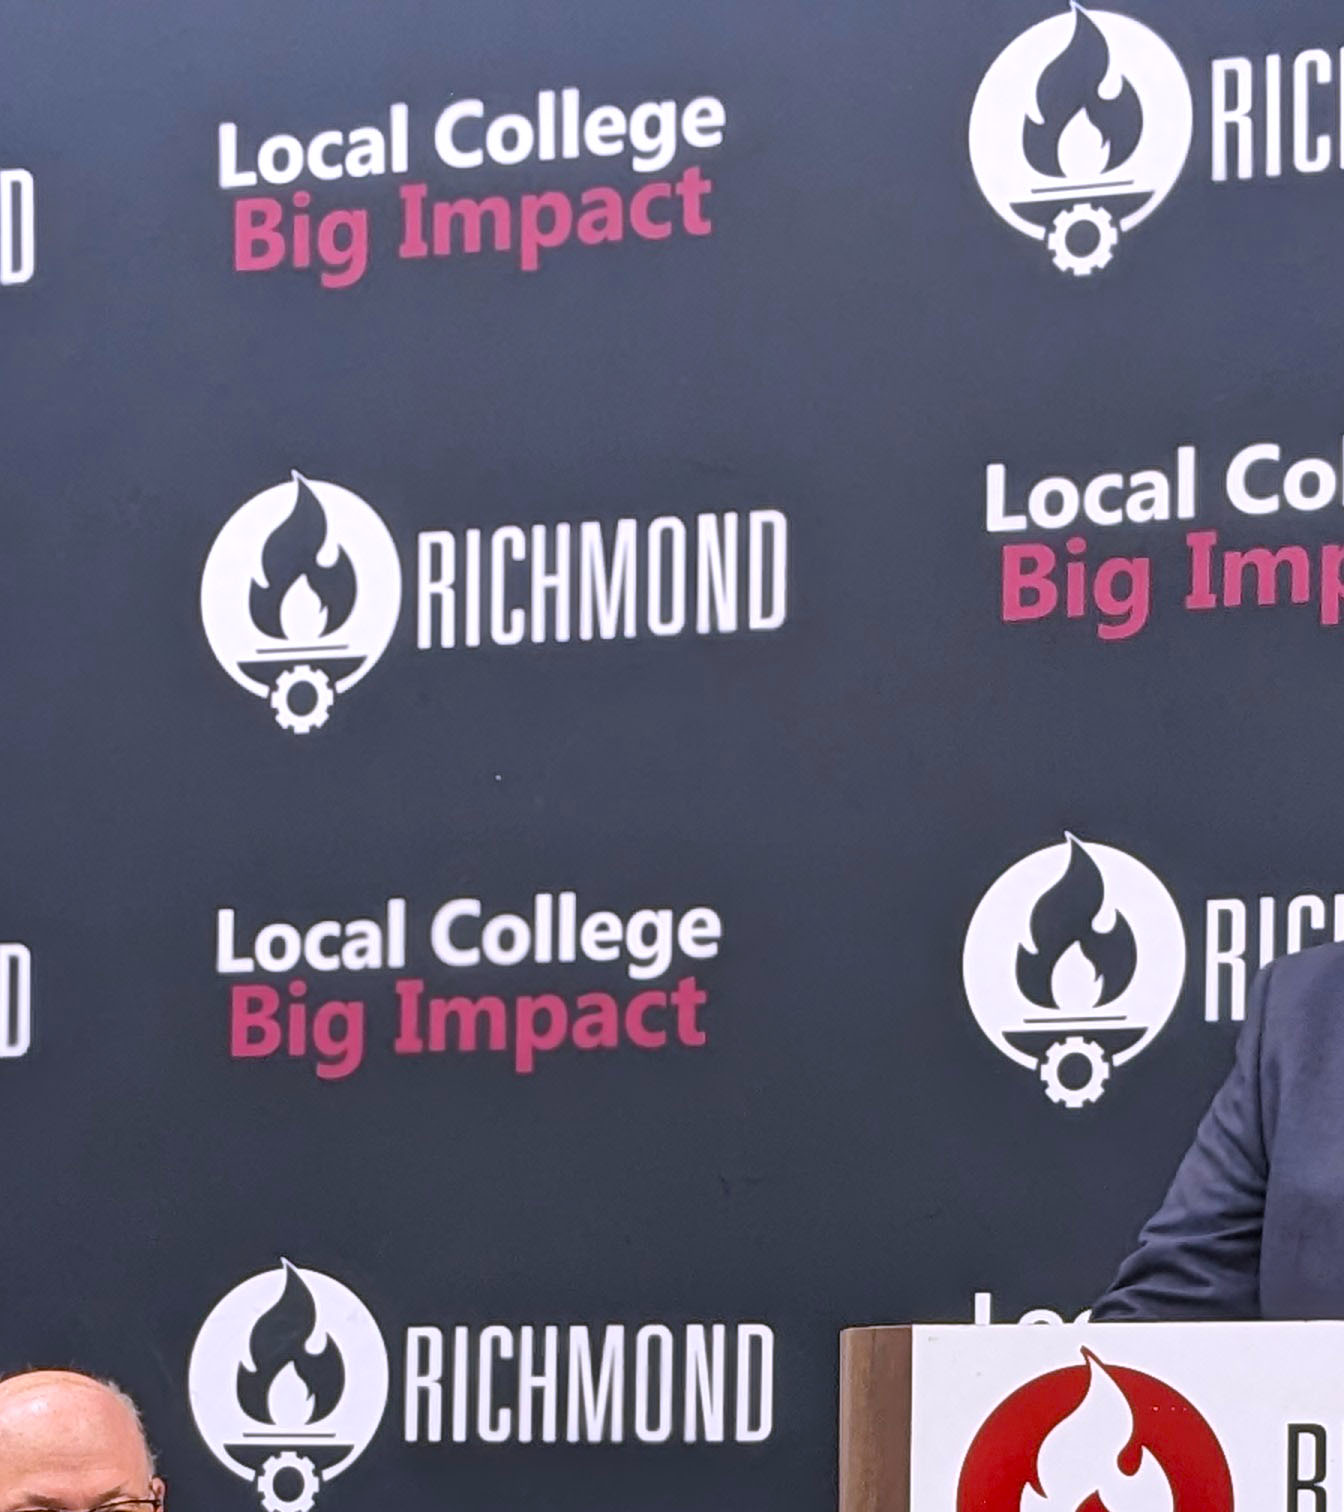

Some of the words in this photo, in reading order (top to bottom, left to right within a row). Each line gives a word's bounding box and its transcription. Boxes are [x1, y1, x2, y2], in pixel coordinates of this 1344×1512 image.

[219, 103, 408, 189] Local
[435, 88, 726, 172] College
[234, 192, 368, 288] Big
[400, 168, 710, 270] Impact
[987, 446, 1195, 532] Local
[418, 510, 787, 649] RICHMOND
[1003, 536, 1150, 640] Big
[217, 899, 405, 973] Local
[432, 892, 721, 979] College
[230, 980, 364, 1078] Big
[396, 978, 706, 1073] Impact
[405, 1324, 773, 1442] RICHMOND
